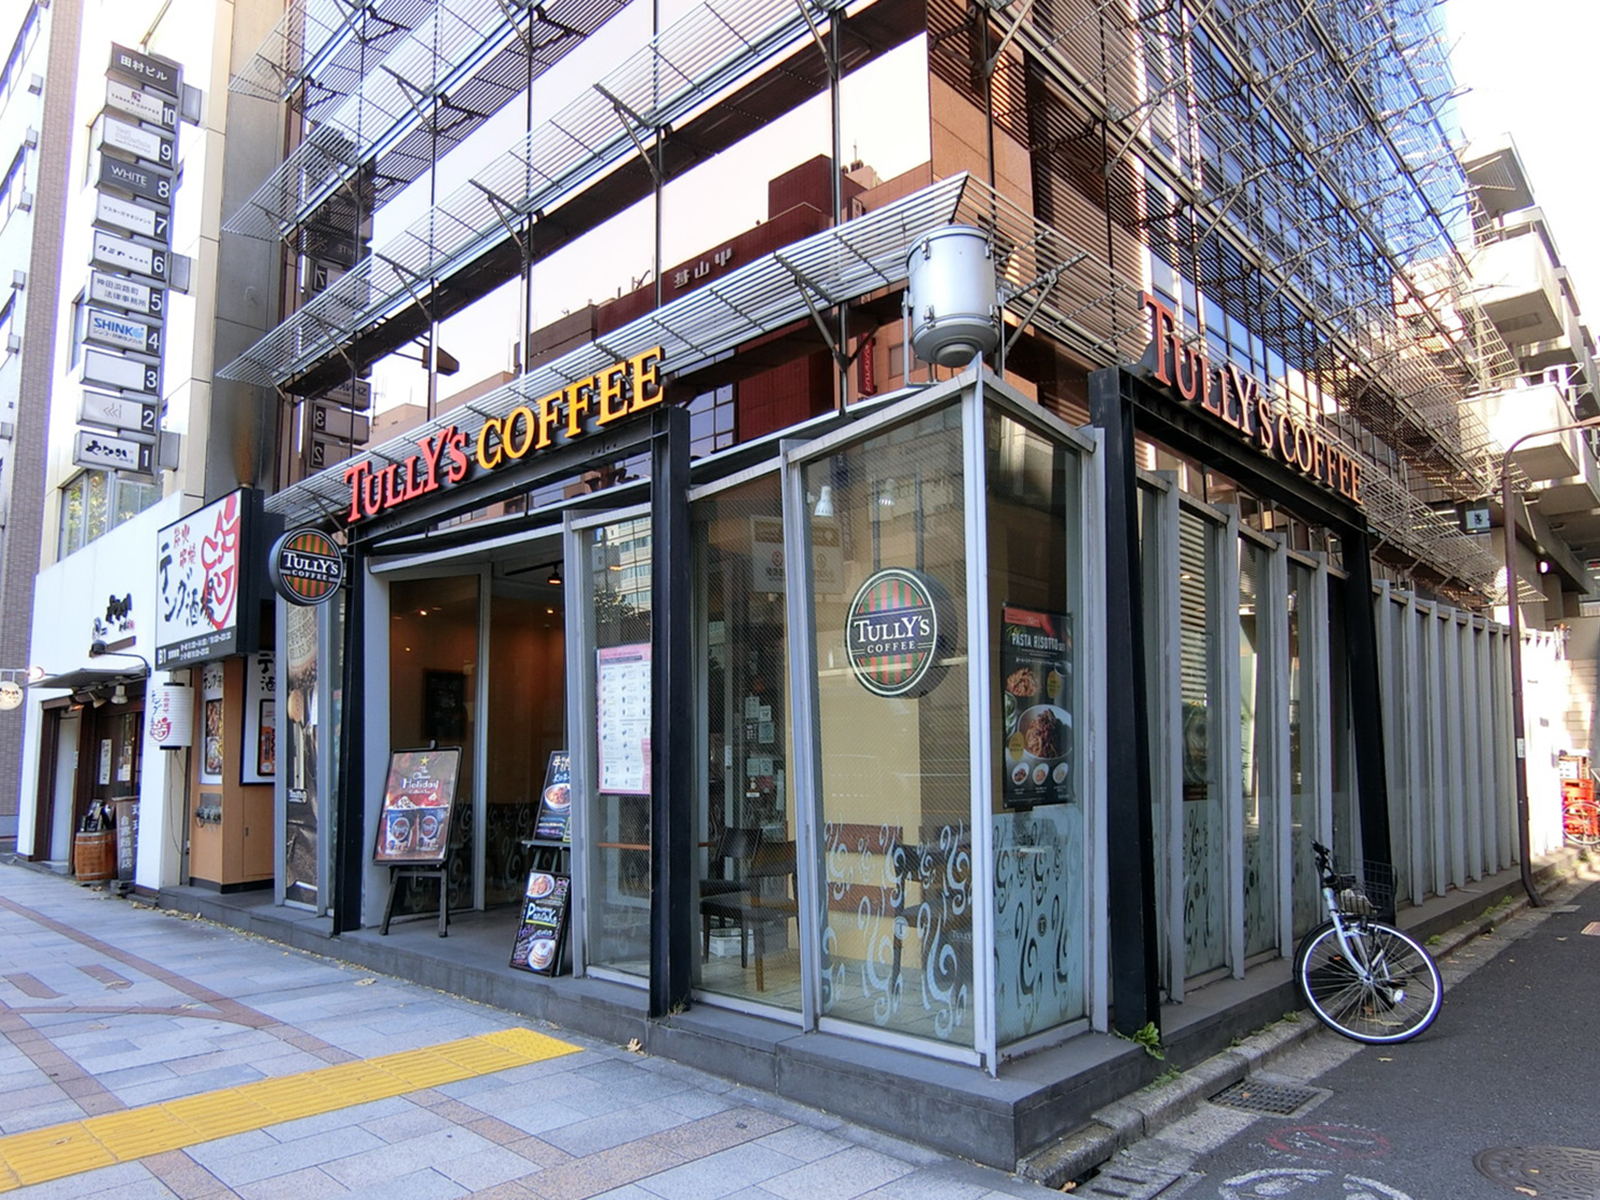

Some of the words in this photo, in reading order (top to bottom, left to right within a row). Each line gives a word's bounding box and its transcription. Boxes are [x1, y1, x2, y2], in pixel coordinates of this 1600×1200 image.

[120, 54, 168, 80] 田村ビル
[163, 107, 176, 125] 10
[160, 143, 172, 161] 9
[110, 165, 148, 186] WHITE
[157, 180, 170, 198] 8
[156, 217, 168, 234] 7
[153, 256, 164, 273] 6
[150, 293, 162, 311] 5
[148, 332, 160, 349] 4
[146, 371, 157, 388] 3
[1137, 290, 1274, 450] TULLY'S
[1278, 413, 1364, 505] COFFEE
[143, 410, 155, 428] 2
[344, 425, 471, 523] TULLY'S
[476, 345, 666, 470] COFFEE
[143, 449, 149, 467] 1
[282, 552, 340, 576] TULLY'S
[291, 568, 328, 581] COFFEE
[853, 615, 931, 643] TULLY'S
[866, 640, 916, 654] COFFEE
[1011, 632, 1033, 648] PASTA
[1033, 635, 1059, 651] RISOTTO
